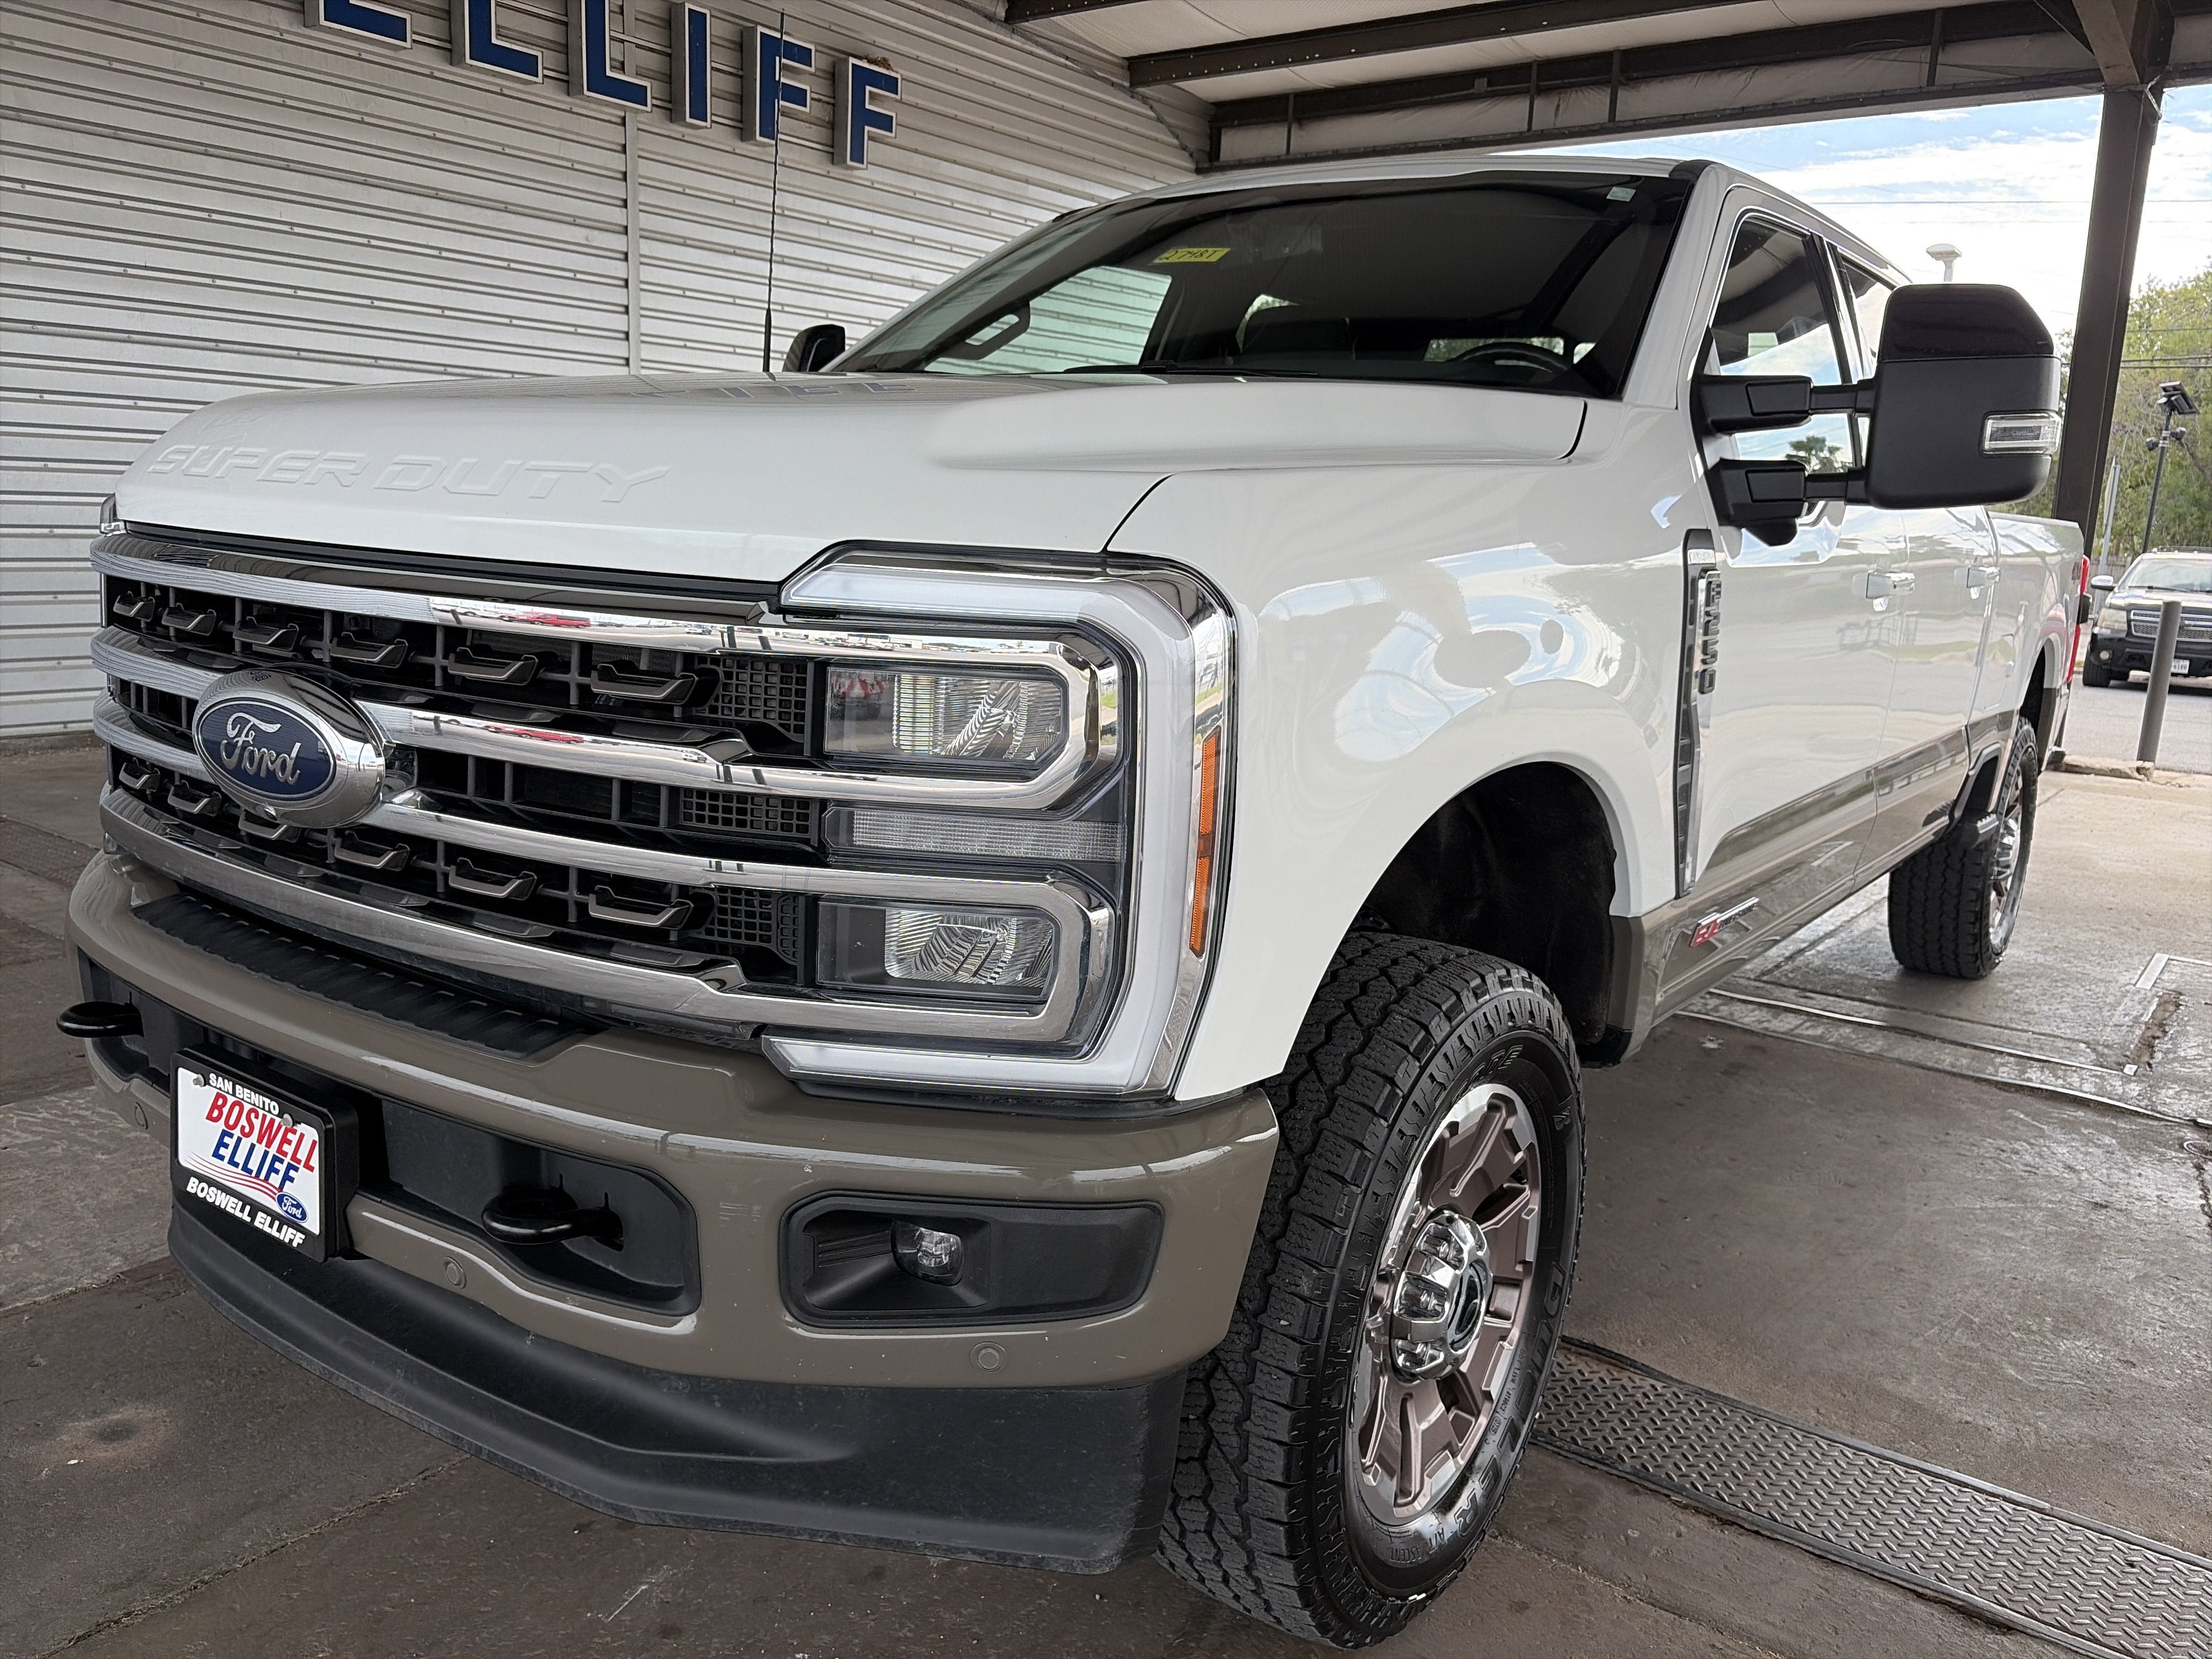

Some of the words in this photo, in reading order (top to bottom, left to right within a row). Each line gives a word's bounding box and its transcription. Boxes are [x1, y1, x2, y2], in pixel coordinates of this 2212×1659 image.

[146, 444, 369, 488] SUPER
[374, 454, 671, 503] DUTY
[219, 712, 302, 786] Ford
[209, 1073, 233, 1094] SAN
[235, 1082, 279, 1115] BENITO
[205, 1091, 319, 1173] BOSWELL
[211, 1128, 301, 1191] ELLIFF
[186, 1176, 252, 1222] BOSWELL
[253, 1213, 306, 1248] ELLIFF
[281, 1197, 303, 1218] Ford
[1429, 1527, 1447, 1554] A/T
